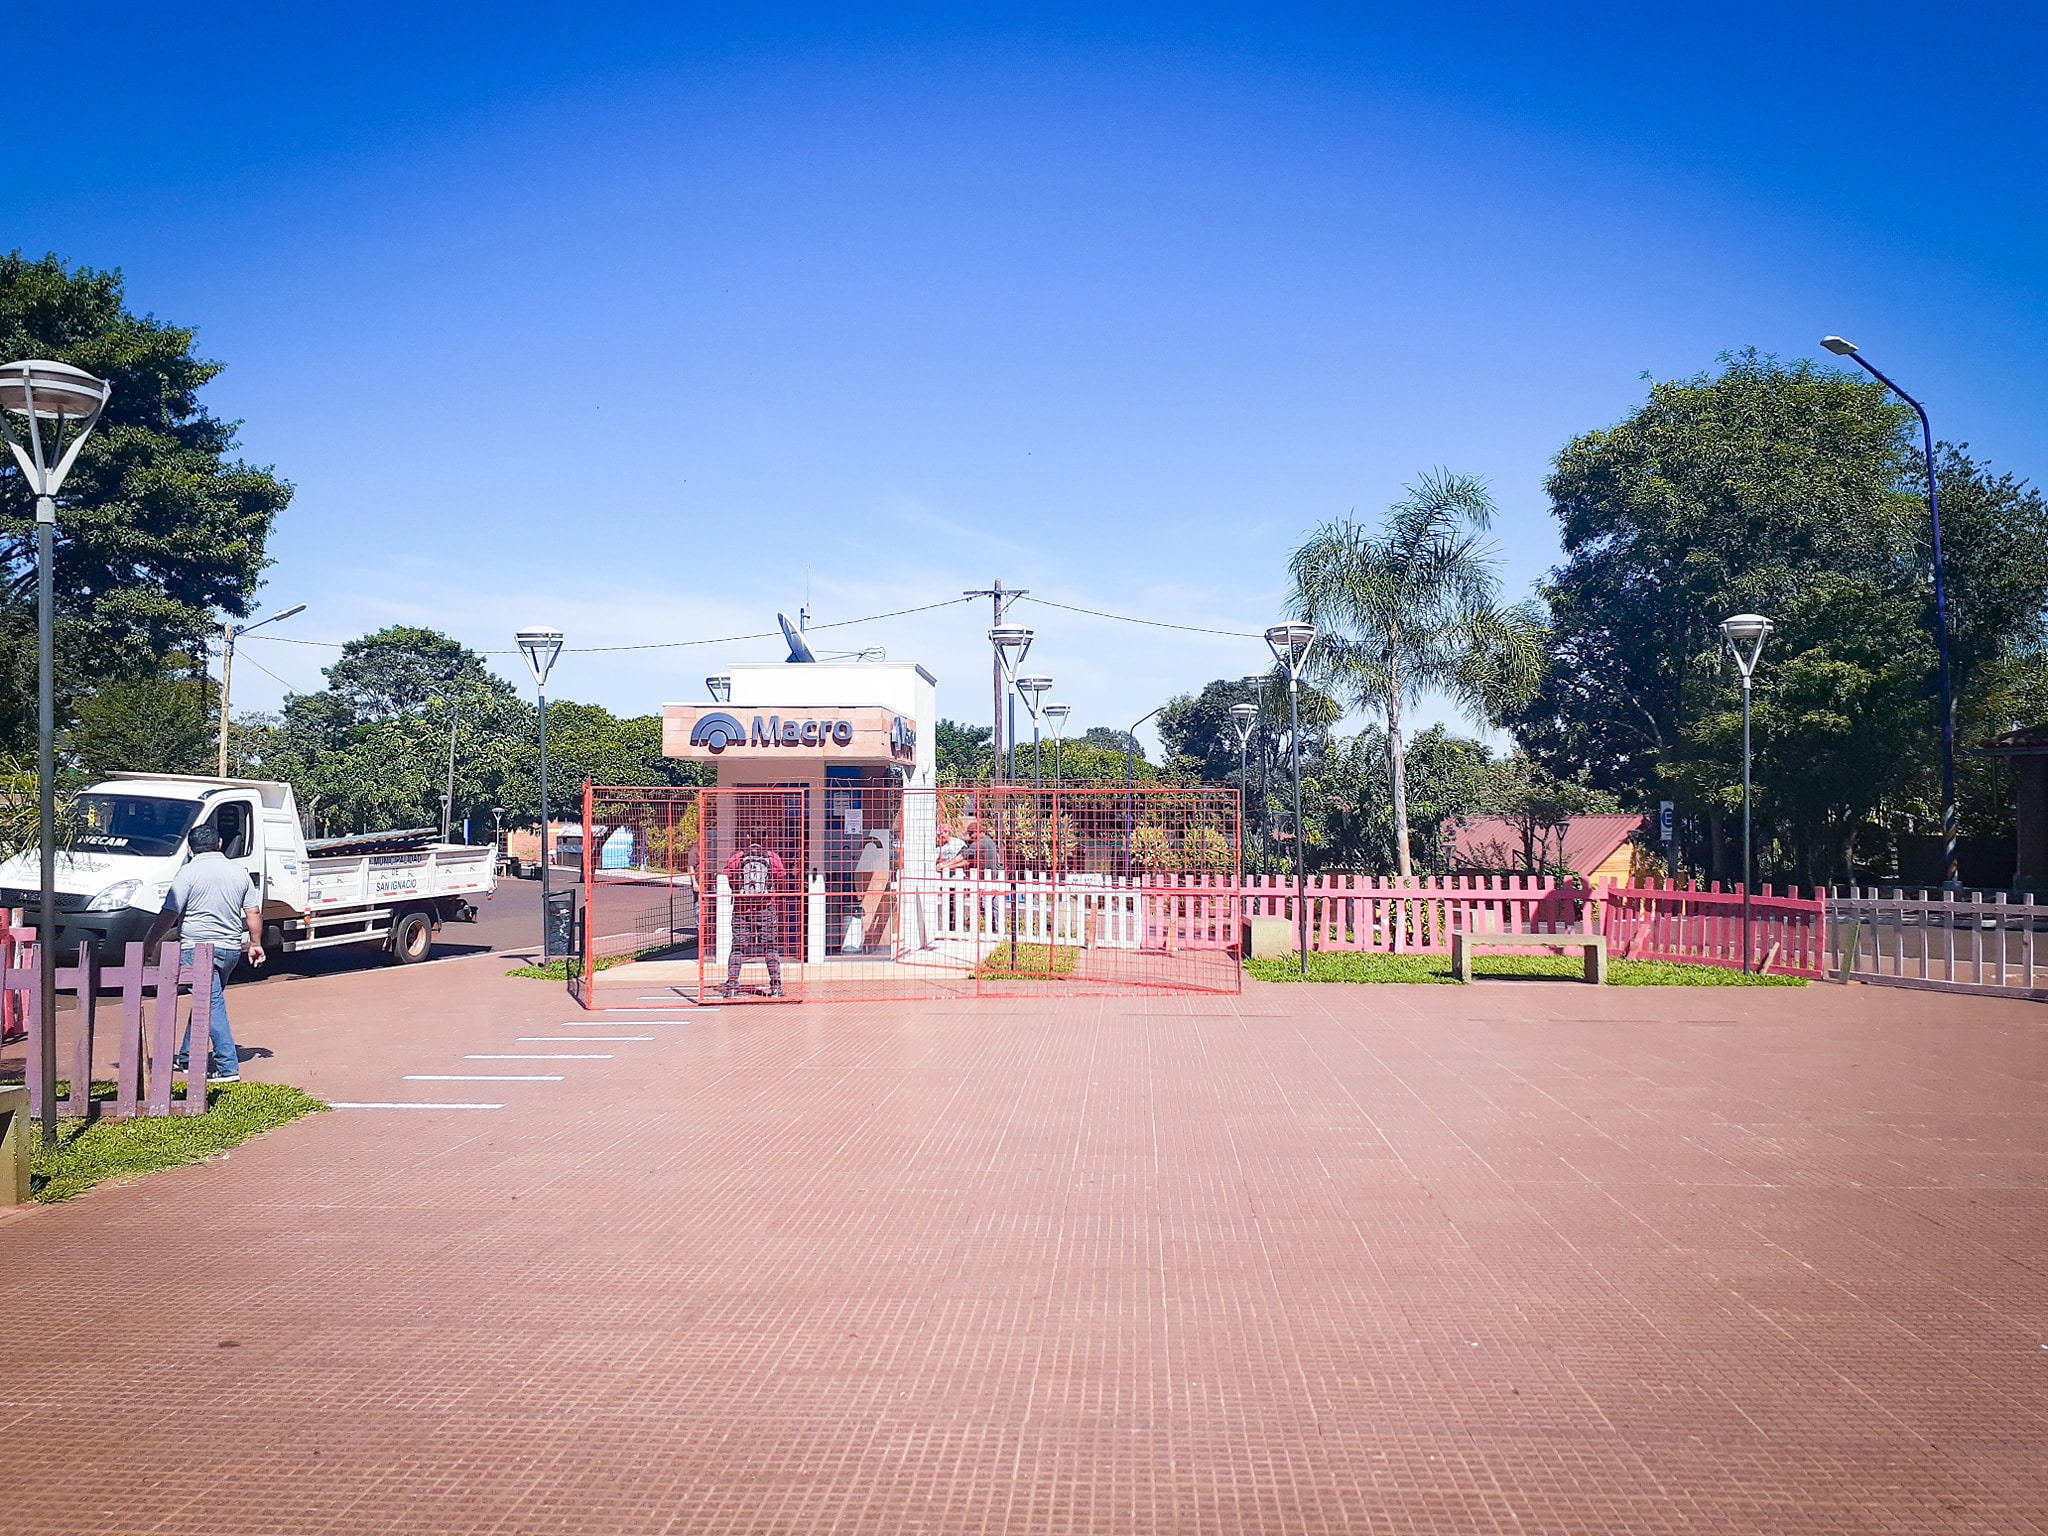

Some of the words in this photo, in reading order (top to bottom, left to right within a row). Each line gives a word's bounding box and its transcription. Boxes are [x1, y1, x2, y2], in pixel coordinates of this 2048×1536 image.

[751, 715, 853, 743] Macro
[1664, 811, 1673, 826] E
[373, 854, 422, 866] MUNICIPALIDAD
[391, 868, 399, 876] DE
[376, 881, 390, 892] SAN
[390, 878, 417, 891] IGNACIO
